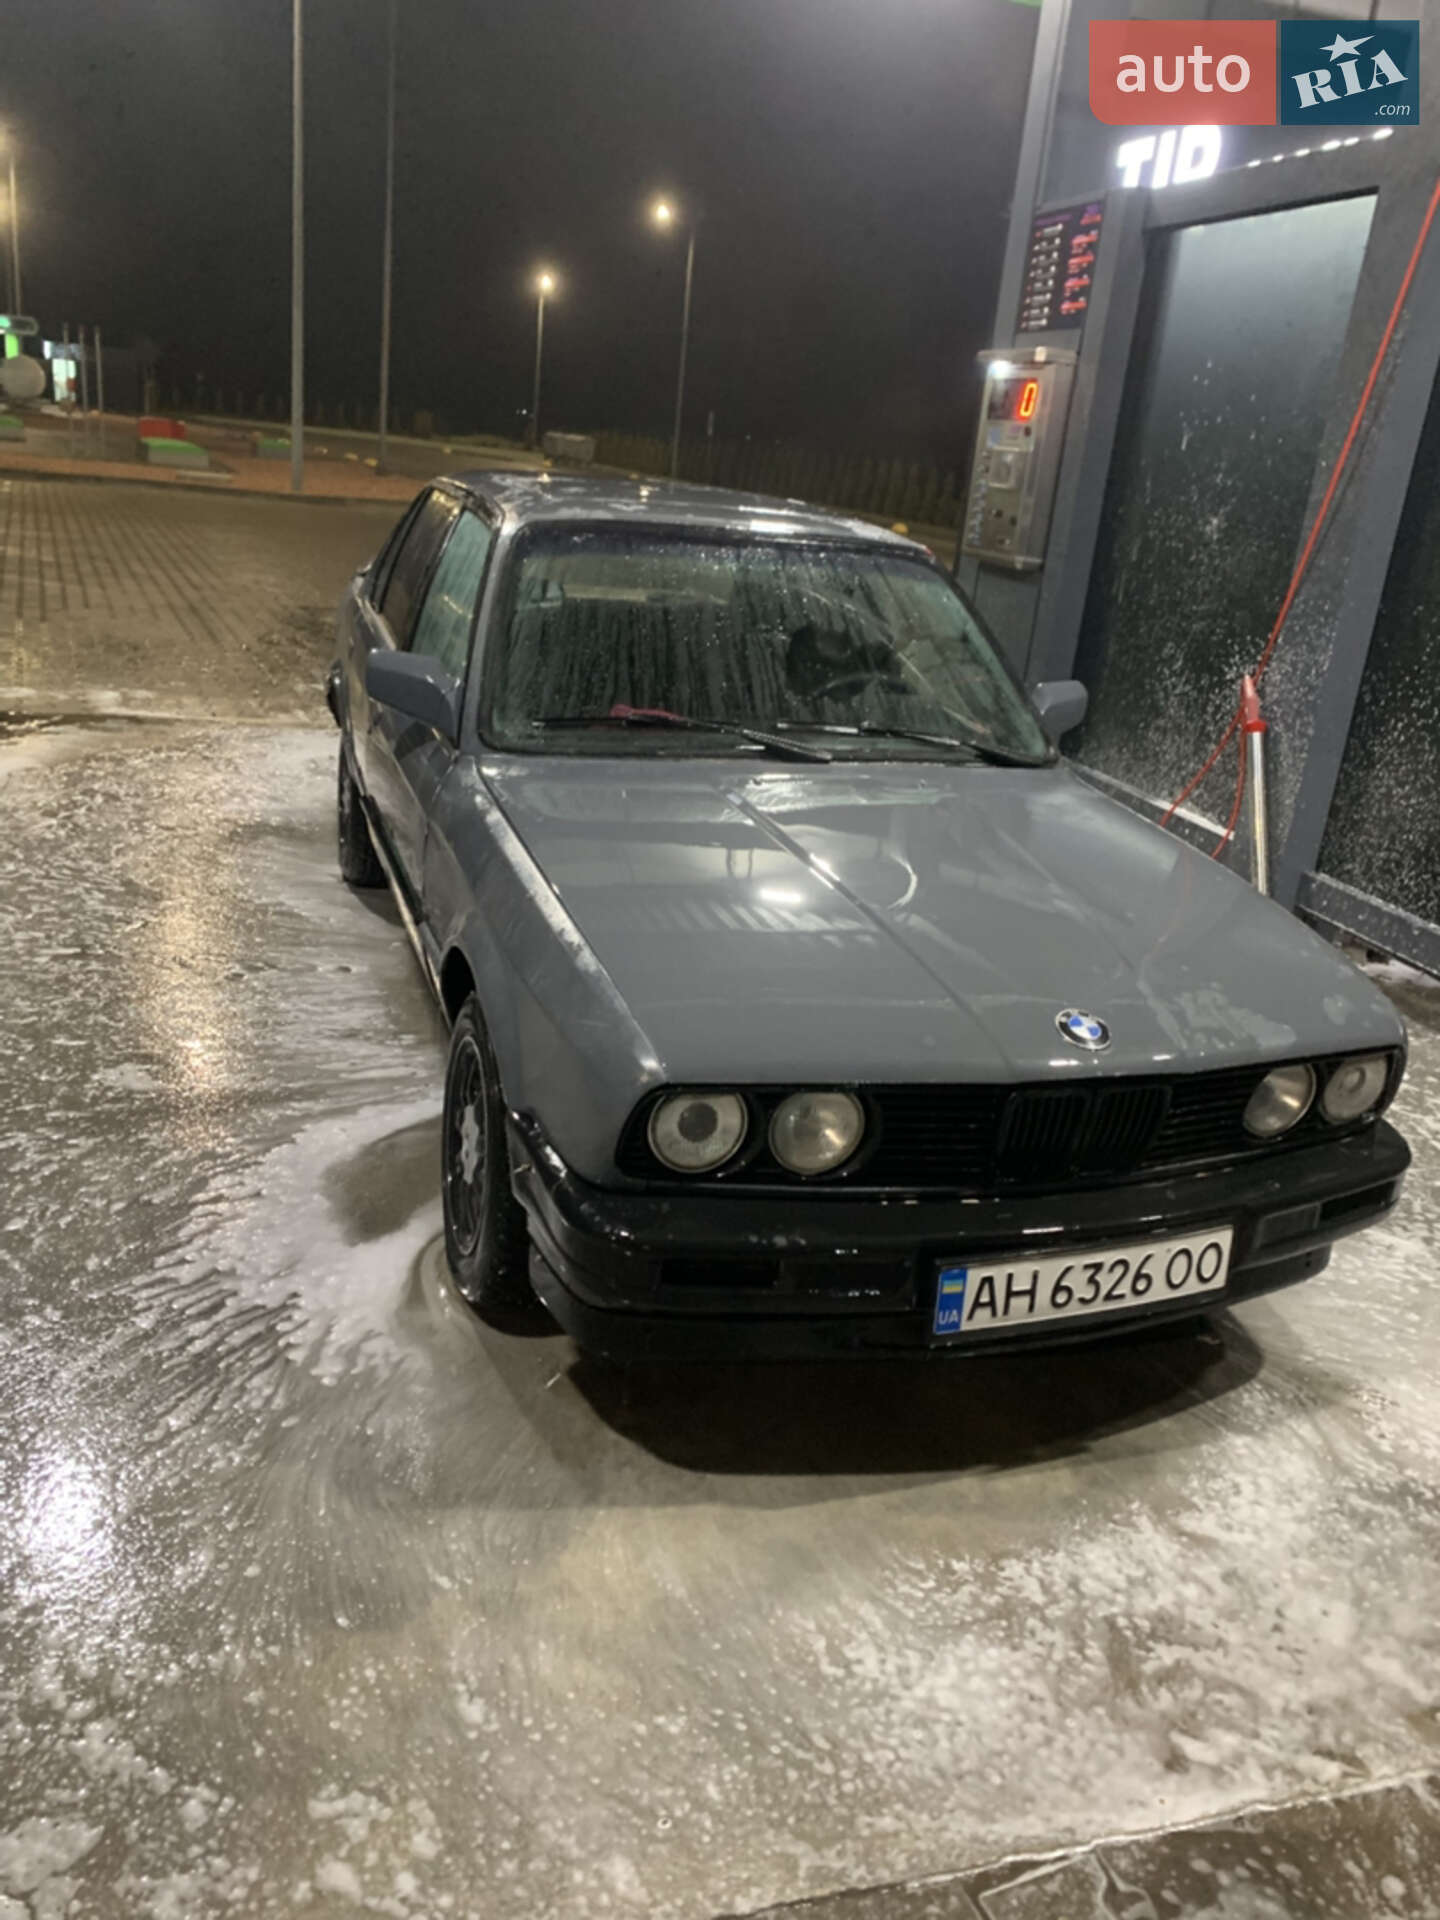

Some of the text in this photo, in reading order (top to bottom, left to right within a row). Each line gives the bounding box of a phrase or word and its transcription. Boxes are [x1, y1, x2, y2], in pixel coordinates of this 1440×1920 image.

[966, 1269, 1039, 1322] AH
[1050, 1252, 1155, 1309] 6326
[938, 1309, 959, 1325] UA
